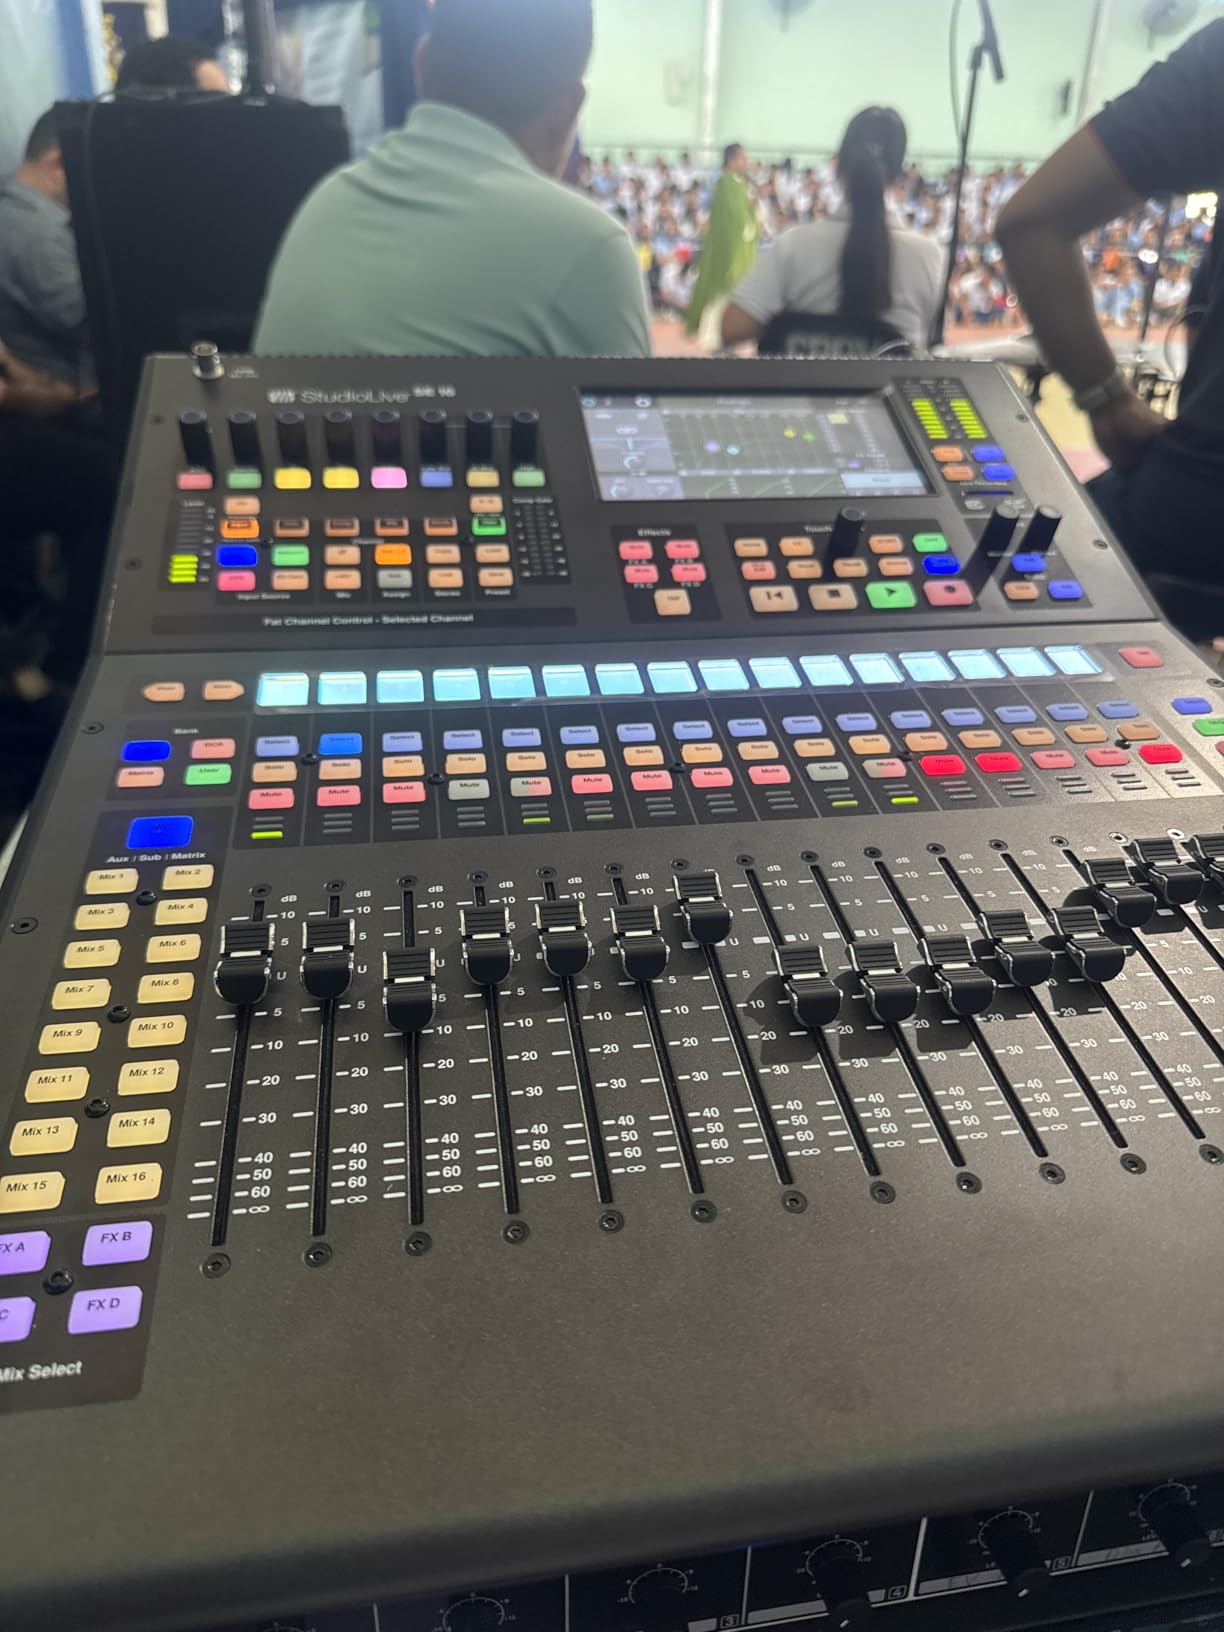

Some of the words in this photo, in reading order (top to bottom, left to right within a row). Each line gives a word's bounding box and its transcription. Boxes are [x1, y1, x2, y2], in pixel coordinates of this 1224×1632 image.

[301, 389, 409, 403] StudioLive
[332, 617, 373, 625] Control
[382, 616, 428, 624] Selected
[430, 615, 473, 623] Channel
[436, 959, 445, 967] U
[358, 965, 367, 973] U
[1178, 967, 1193, 975] 10
[277, 972, 286, 980] U
[439, 994, 446, 1002] 5
[1200, 995, 1215, 1004] 20
[358, 1001, 365, 1009] 5
[274, 1008, 282, 1016] 5
[1061, 1008, 1076, 1016] 20
[437, 1026, 452, 1034] 10
[353, 1033, 369, 1042] 10
[760, 1031, 776, 1040] 20
[1153, 1032, 1169, 1041] 30
[267, 1041, 283, 1049] 10
[603, 1044, 619, 1053] 20
[1007, 1046, 1023, 1055] 30
[521, 1051, 537, 1061] 20
[438, 1059, 454, 1068] 20
[852, 1058, 868, 1068] 30
[153, 1067, 164, 1075] 12
[352, 1067, 368, 1077] 20
[692, 1071, 708, 1081] 30
[262, 1076, 280, 1086] 20
[1103, 1072, 1118, 1081] 40
[1185, 1077, 1201, 1087] 50
[526, 1087, 543, 1096] 30
[949, 1086, 964, 1096] 40
[439, 1095, 456, 1105] 30
[1034, 1093, 1050, 1103] 50
[350, 1104, 368, 1114] 30
[786, 1100, 803, 1110] 40
[1120, 1099, 1136, 1109] 60
[259, 1113, 276, 1123] 30
[874, 1108, 891, 1118] 50
[618, 1115, 634, 1125] 40
[962, 1115, 979, 1126] 60
[22, 1128, 41, 1136] Mix
[47, 1126, 59, 1134] 13
[531, 1124, 548, 1134] 40
[707, 1123, 724, 1133] 50
[441, 1133, 459, 1143] 40
[796, 1131, 814, 1141] 60
[349, 1143, 367, 1153] 40
[533, 1139, 550, 1150] 50
[254, 1152, 273, 1163] 40
[442, 1149, 460, 1160] 50
[624, 1147, 642, 1158] 60
[349, 1159, 367, 1170] 50
[535, 1156, 552, 1167] 60
[253, 1169, 272, 1180] 50
[443, 1166, 461, 1177] 60
[106, 1175, 128, 1183] Mix
[133, 1172, 146, 1181] 16
[348, 1176, 367, 1187] 60
[6, 1183, 28, 1192] Mix
[34, 1181, 46, 1189] 15
[251, 1186, 270, 1197] 60
[101, 1233, 118, 1243] FX
[123, 1232, 131, 1240] B
[15, 1243, 25, 1251] A
[87, 1300, 105, 1310] FX
[110, 1298, 120, 1309] D
[29, 1361, 82, 1379] Select
